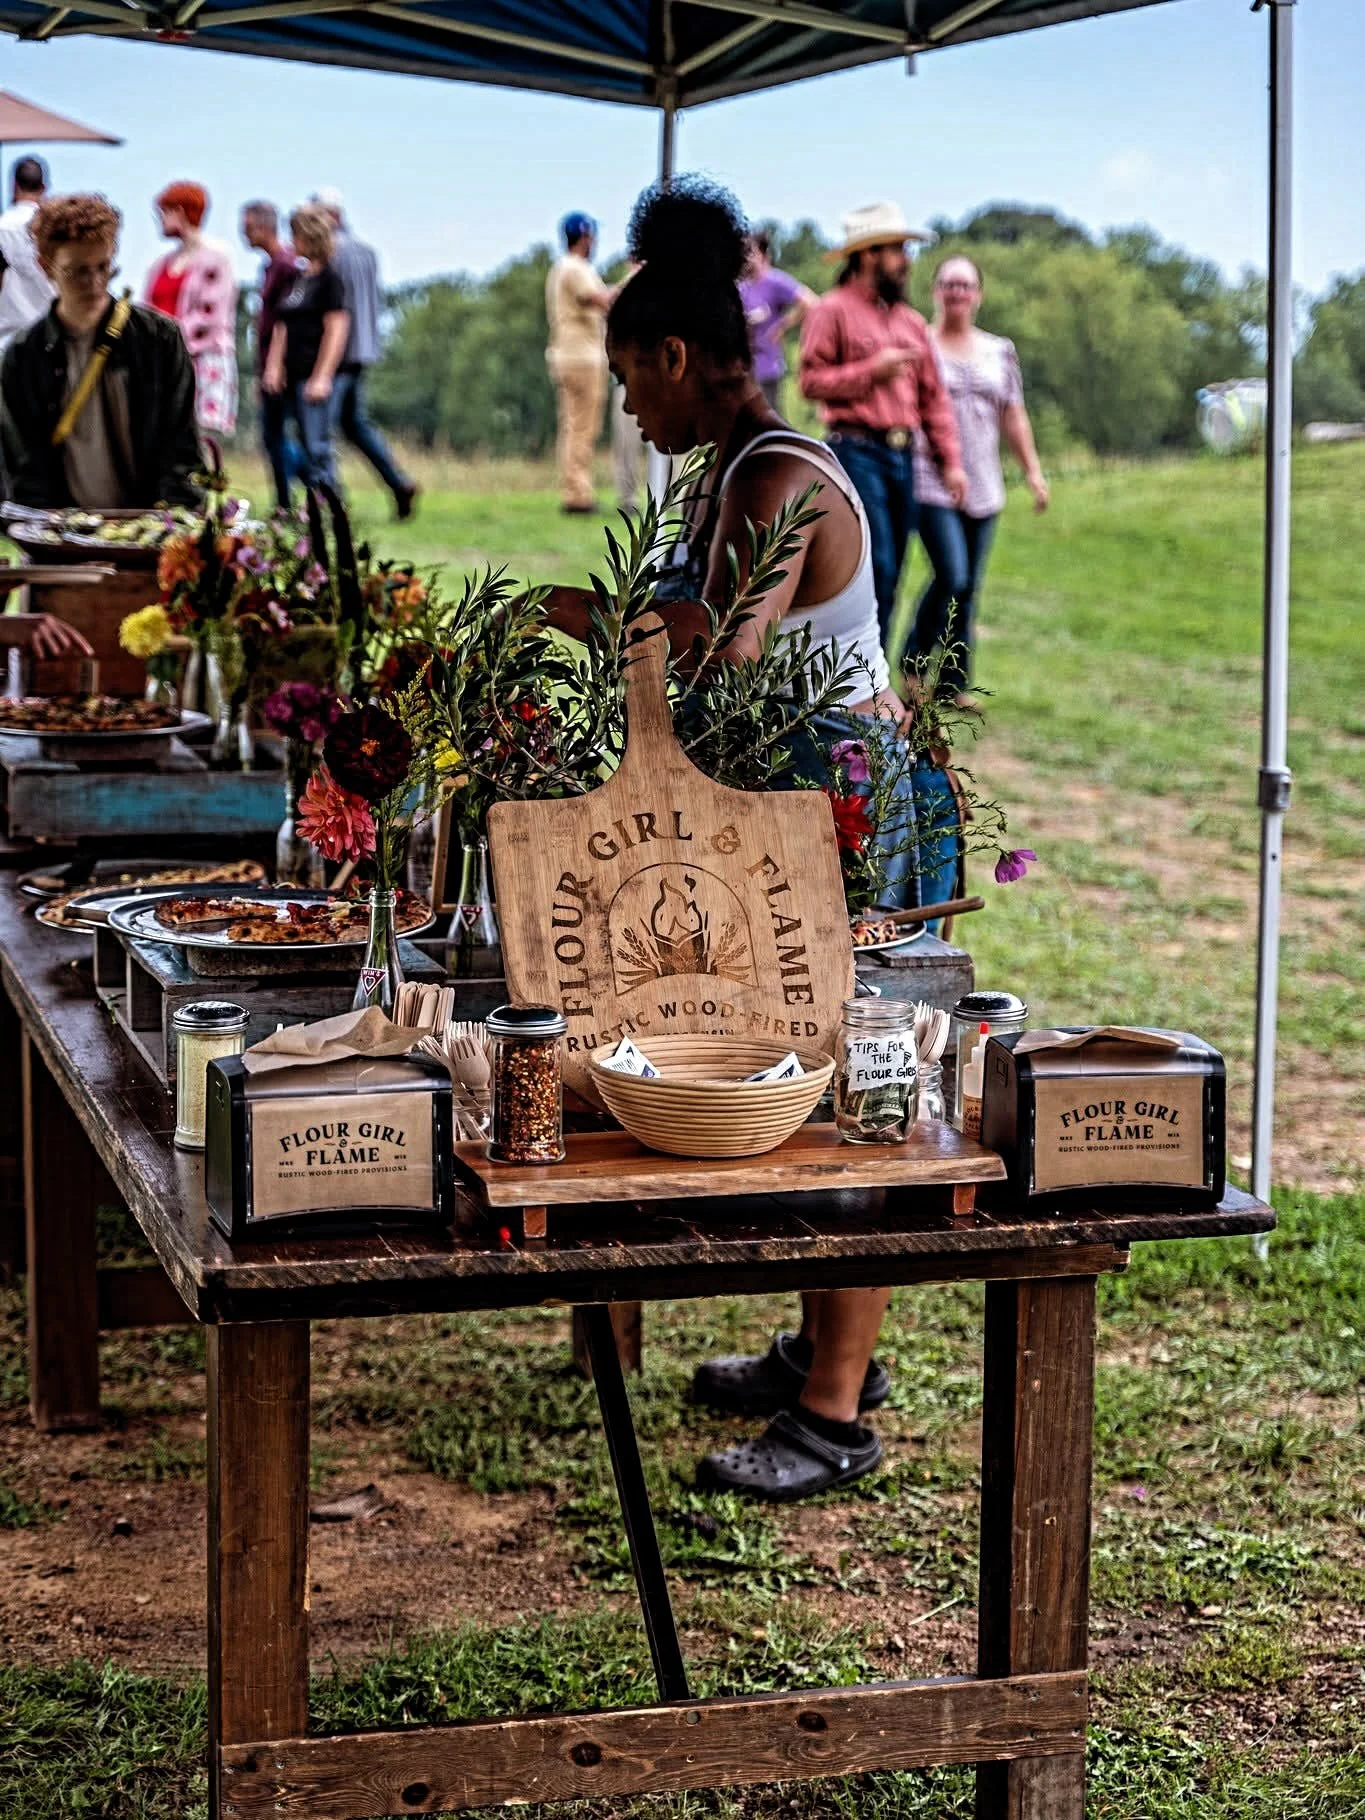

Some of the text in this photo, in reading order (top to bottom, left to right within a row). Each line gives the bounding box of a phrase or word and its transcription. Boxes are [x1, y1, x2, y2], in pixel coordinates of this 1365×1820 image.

[551, 810, 815, 1018] FLOUR GIRL & FLAME
[566, 1000, 819, 1052] RUSTIC WOOD-FIRED
[853, 1041, 905, 1054] TIPS FOR
[871, 1053, 892, 1064] THE
[857, 1068, 893, 1082] FLOUR
[1060, 1100, 1180, 1128] FLOUR GIRL
[1116, 1115, 1124, 1125] &
[279, 1122, 407, 1152] FLOUR GIRL
[1084, 1124, 1154, 1141] FLAME
[339, 1138, 348, 1148] &
[1087, 1144, 1134, 1152] WOOD-FIRED
[1136, 1143, 1180, 1151] PROVISIONS
[306, 1147, 380, 1166] FLAME
[309, 1168, 359, 1177] WOOD-FIRED
[361, 1165, 407, 1174] PROVISIONS
